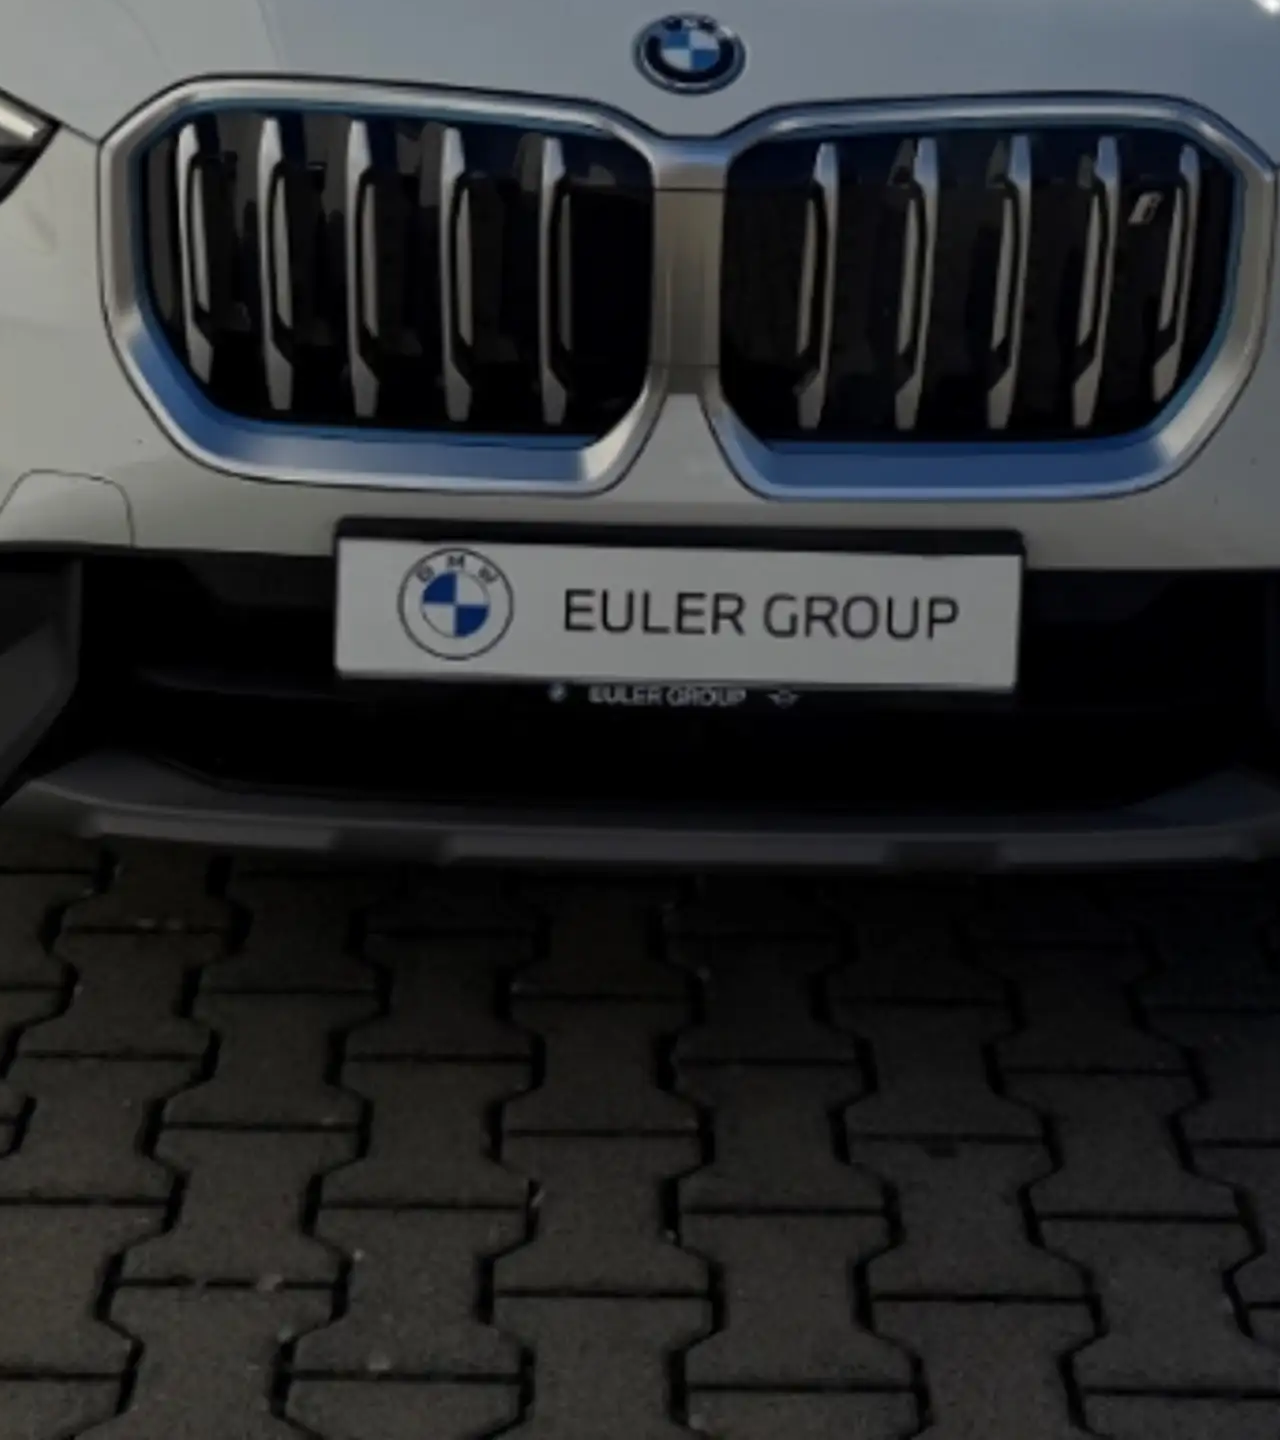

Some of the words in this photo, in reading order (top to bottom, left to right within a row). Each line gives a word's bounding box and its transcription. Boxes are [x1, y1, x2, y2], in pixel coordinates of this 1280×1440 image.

[416, 553, 500, 584] BMW
[563, 588, 746, 636] EULER
[763, 593, 960, 641] GROUP
[588, 684, 663, 706] EULER
[666, 685, 747, 707] GROUP
